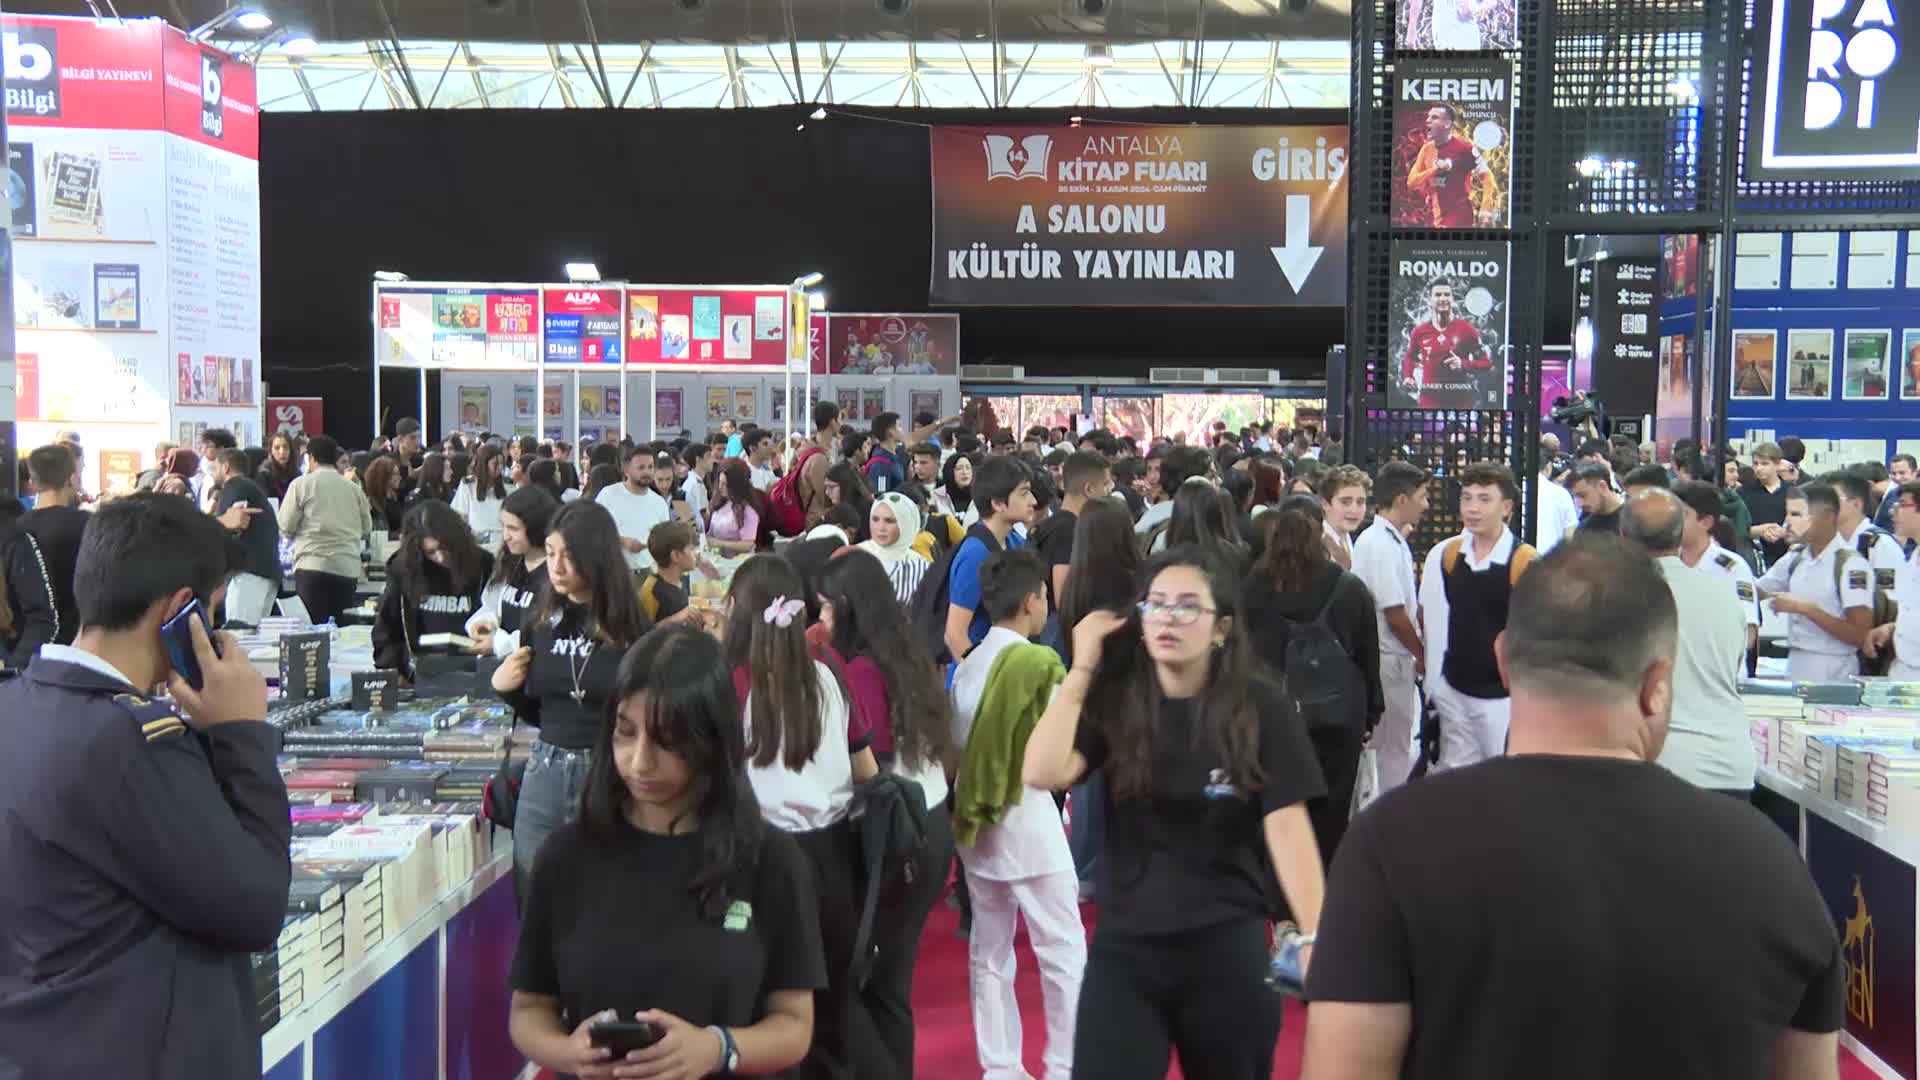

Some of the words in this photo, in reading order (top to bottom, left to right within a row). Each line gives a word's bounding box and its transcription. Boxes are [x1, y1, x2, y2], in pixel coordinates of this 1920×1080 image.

[61, 67, 95, 80] BİLGİ
[96, 68, 153, 82] YAYINEVİ
[1402, 79, 1505, 101] KEREM
[5, 88, 56, 115] Bilgi
[203, 110, 223, 137] Bilgi
[1082, 136, 1184, 155] ANTALYA
[1009, 150, 1028, 163] 14.
[1058, 156, 1130, 181] KİTAP
[1134, 161, 1208, 181] FUARI
[1016, 205, 1038, 233] A
[1047, 204, 1166, 234] SALONU
[947, 242, 1062, 279] KÜLTÜR
[1072, 249, 1235, 279] YAYINLARI
[1399, 260, 1499, 277] RONALDO
[565, 292, 601, 305] ALFA
[551, 637, 595, 657] NYC
